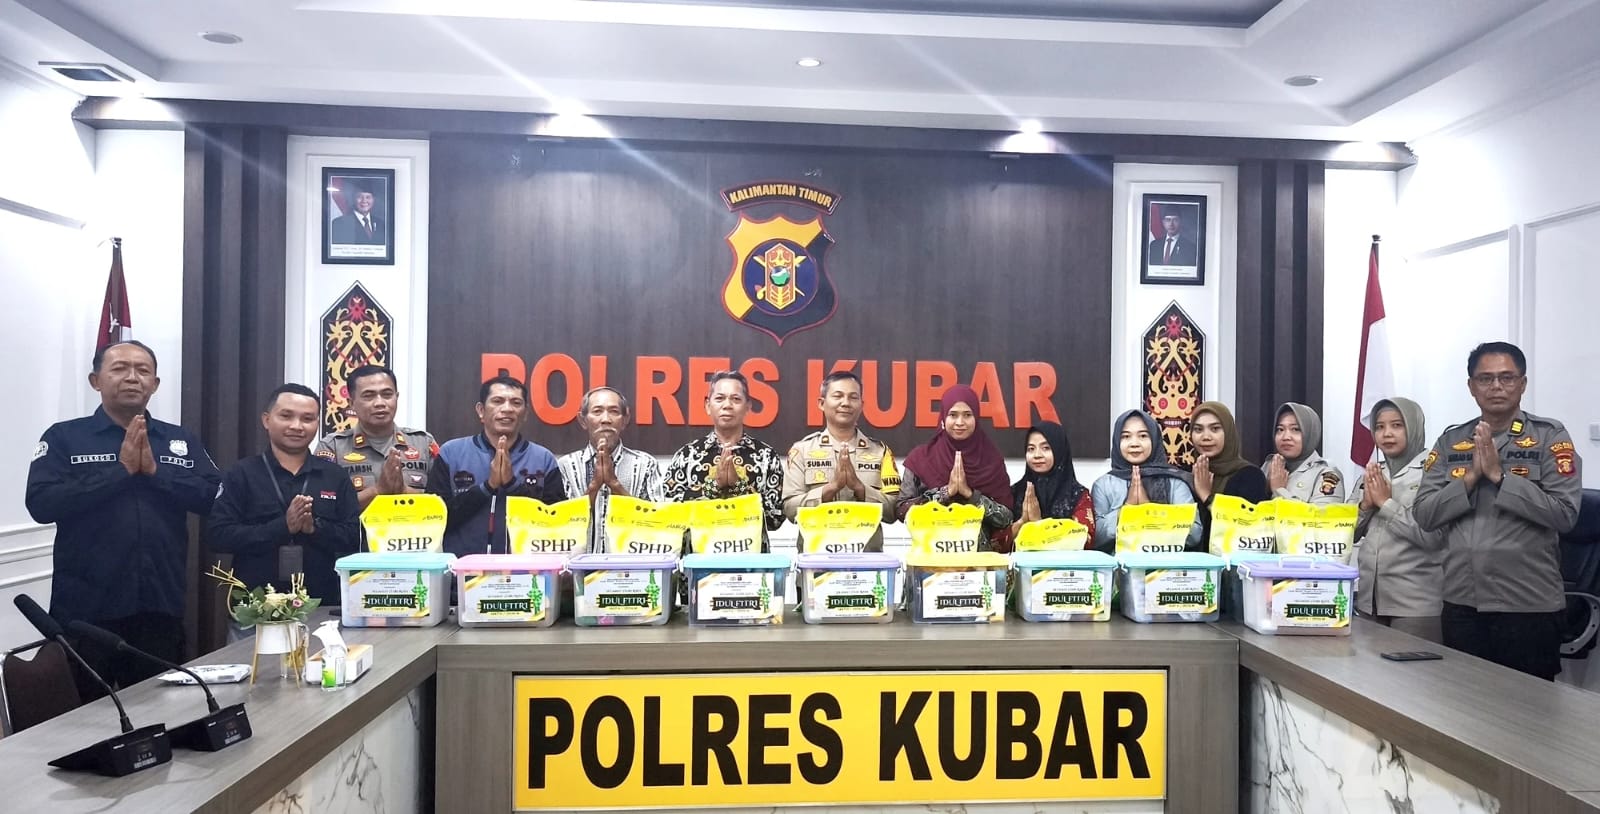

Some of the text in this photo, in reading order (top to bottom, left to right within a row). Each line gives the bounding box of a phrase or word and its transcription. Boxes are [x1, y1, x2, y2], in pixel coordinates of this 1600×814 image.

[729, 184, 832, 208] KALIMANTAN TIMUR
[807, 359, 1062, 428] KUBAR
[1507, 451, 1539, 460] POLRI
[400, 461, 427, 470] POLRI
[387, 536, 433, 551] SPHP
[531, 539, 577, 552] SPHP
[628, 541, 672, 554] SPHP
[713, 538, 753, 553] SPHP
[935, 540, 975, 553] SPHP
[1304, 542, 1347, 554] SPHP
[528, 690, 1151, 789] POLRES KUBAR
